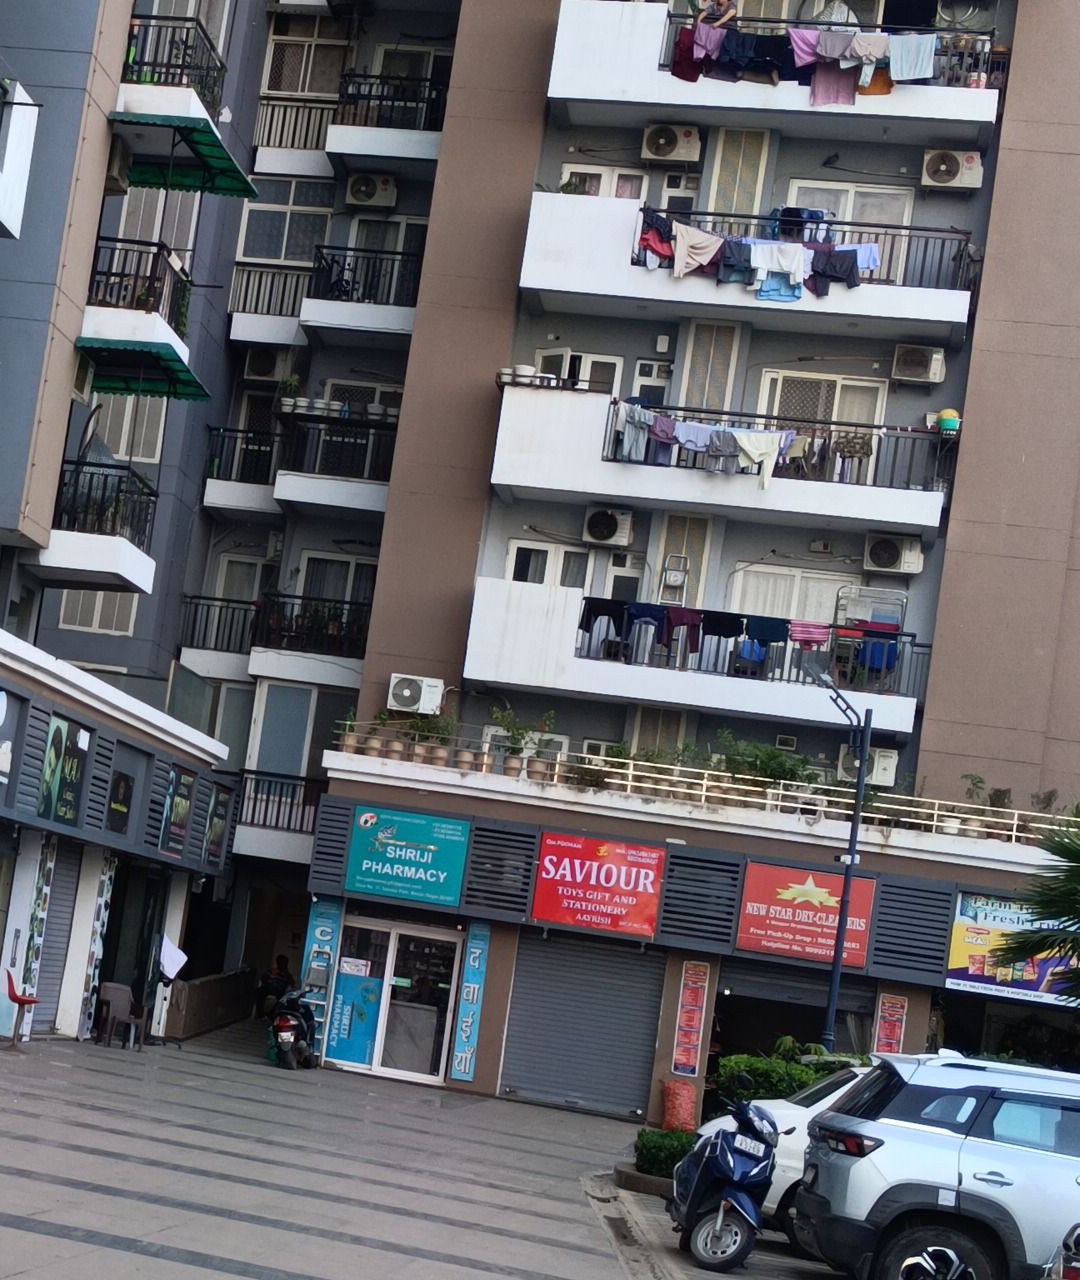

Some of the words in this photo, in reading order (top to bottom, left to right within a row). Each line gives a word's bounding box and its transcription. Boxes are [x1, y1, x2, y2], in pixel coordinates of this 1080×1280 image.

[385, 845, 433, 864] SHRIJI
[361, 859, 448, 884] PHARMACY
[541, 855, 656, 894] SAVIOUR
[556, 885, 584, 899] TOYS
[586, 890, 611, 901] GIFT
[612, 894, 637, 905] AND
[561, 898, 628, 916] STATIONERY
[745, 901, 768, 917] NEW
[768, 906, 793, 921] STAR
[794, 908, 867, 931] DRY-CLEAERS
[329, 994, 344, 1048] PHARMACY
